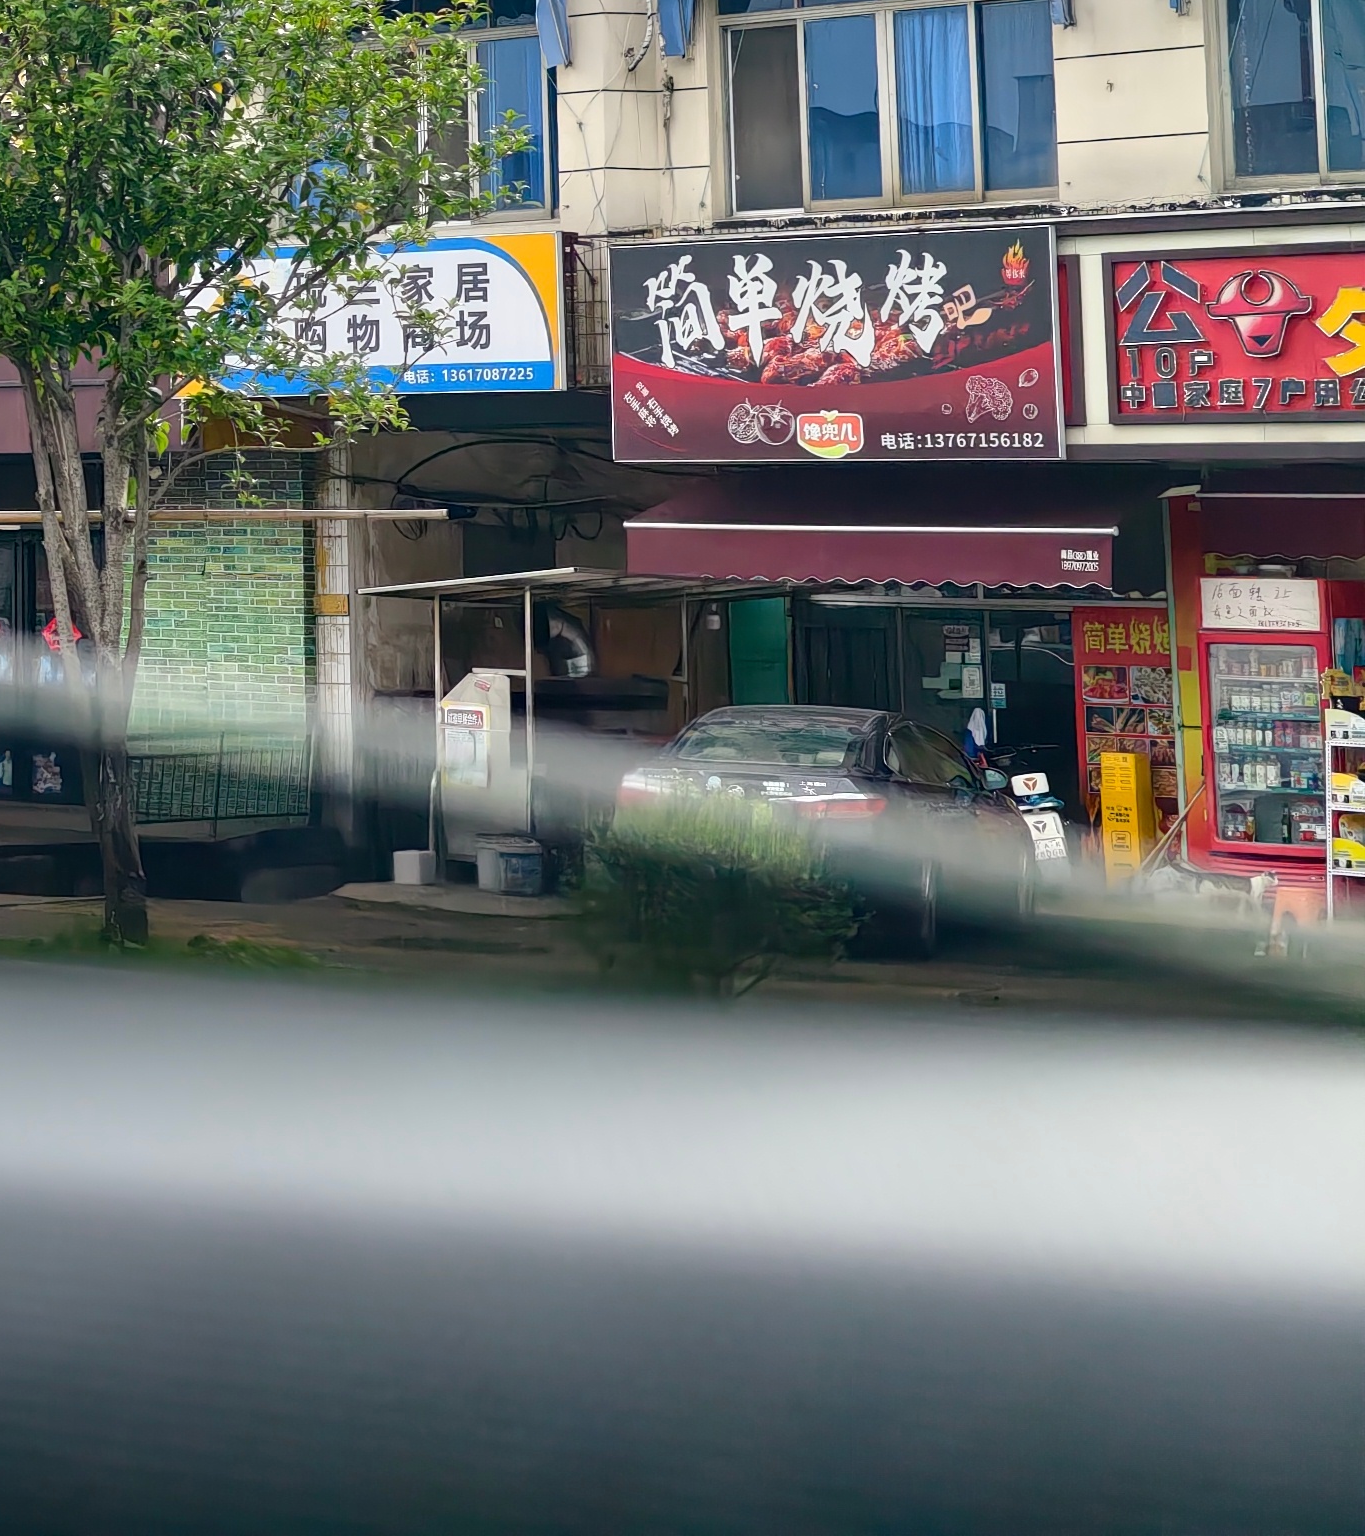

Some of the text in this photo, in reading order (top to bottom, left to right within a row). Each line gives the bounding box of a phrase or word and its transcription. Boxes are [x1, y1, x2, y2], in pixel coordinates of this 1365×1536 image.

[1116, 261, 1207, 345] 公
[295, 310, 491, 354] 购物商场
[803, 422, 858, 442] 馋兜儿
